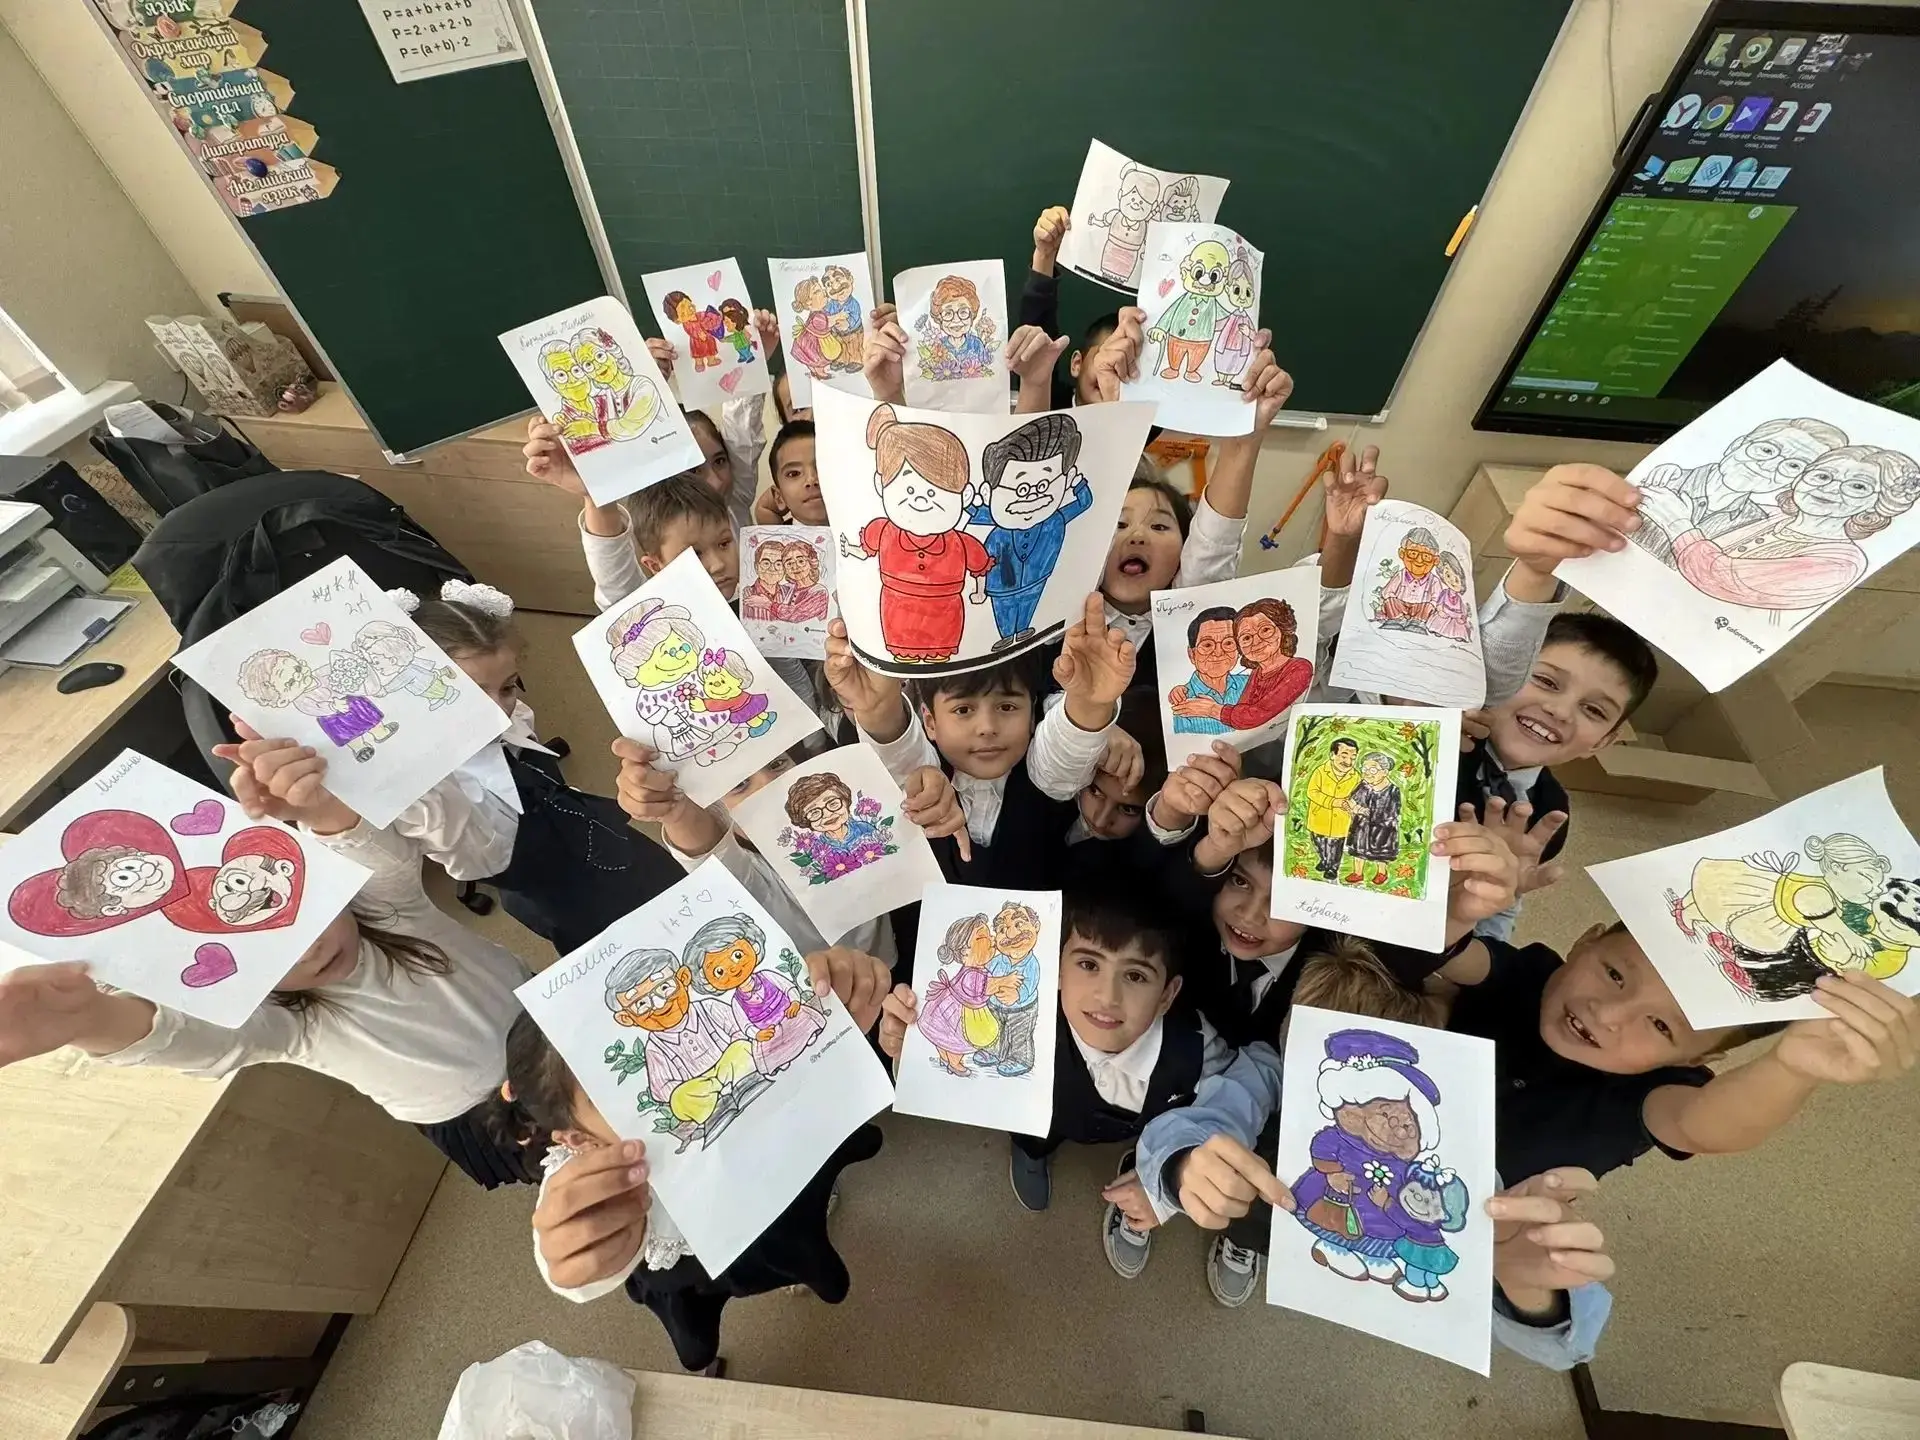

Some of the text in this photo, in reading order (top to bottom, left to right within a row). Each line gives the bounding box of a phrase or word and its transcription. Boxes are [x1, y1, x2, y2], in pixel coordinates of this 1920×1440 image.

[131, 29, 240, 60] Окружающий
[180, 52, 212, 69] мир
[168, 79, 264, 108] Спортивный
[212, 101, 241, 119] зал
[200, 132, 290, 160] Литература
[227, 166, 313, 197] Английский
[262, 189, 300, 206] язык
